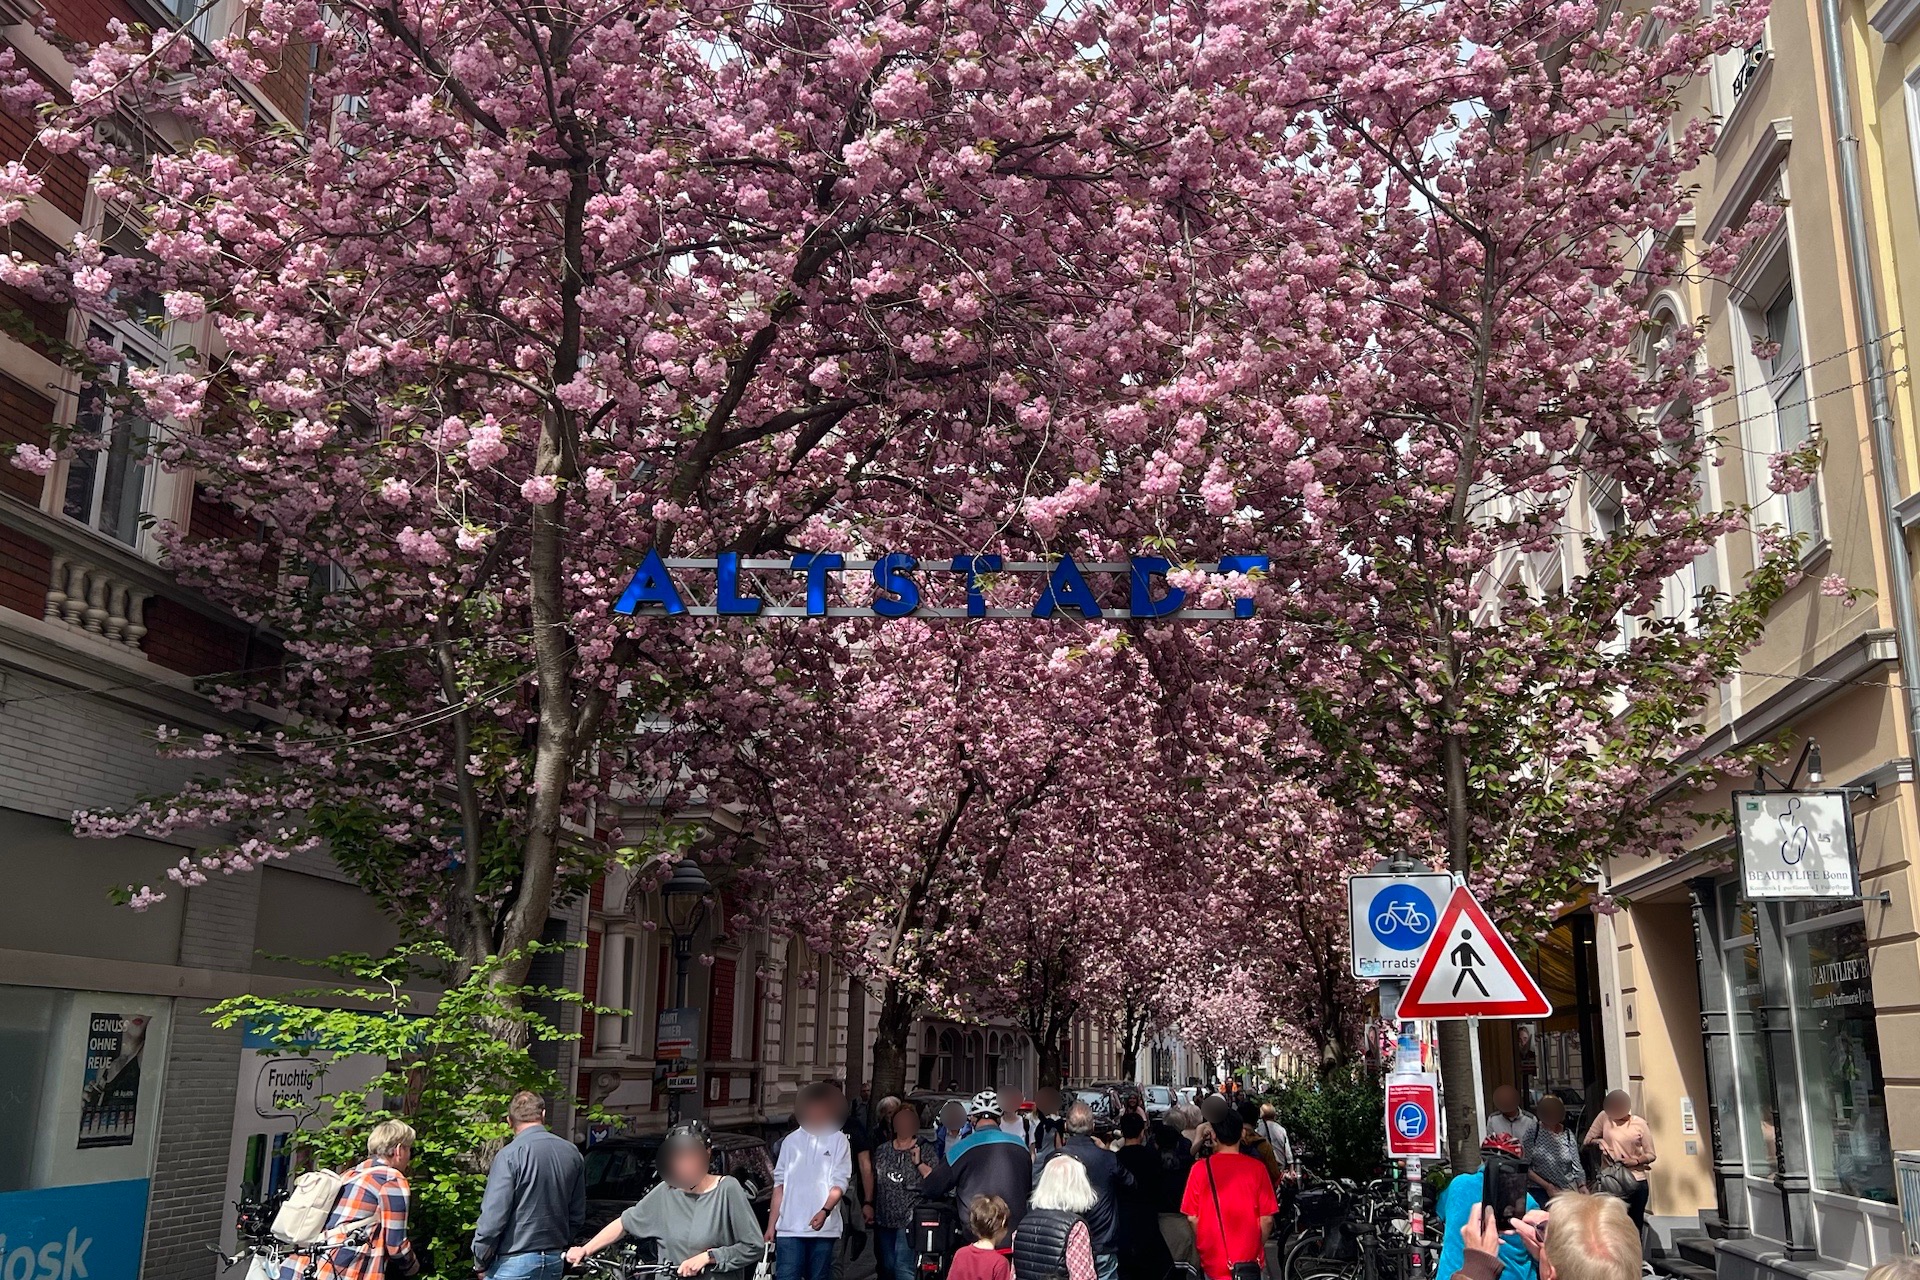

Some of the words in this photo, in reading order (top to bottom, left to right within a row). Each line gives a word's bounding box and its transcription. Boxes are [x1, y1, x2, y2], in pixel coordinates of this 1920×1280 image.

[612, 547, 1270, 617] ALTSTADT
[1748, 870, 1820, 881] BEAUTYLIFE
[1823, 870, 1849, 880] Bonn
[1807, 959, 1860, 987] BEAUTYLIFE
[91, 1018, 130, 1032] GENUSS
[89, 1037, 118, 1051] OHNE
[87, 1056, 113, 1070] REUE
[268, 1068, 314, 1091] Fruchtig
[0, 1226, 94, 1280] osk
